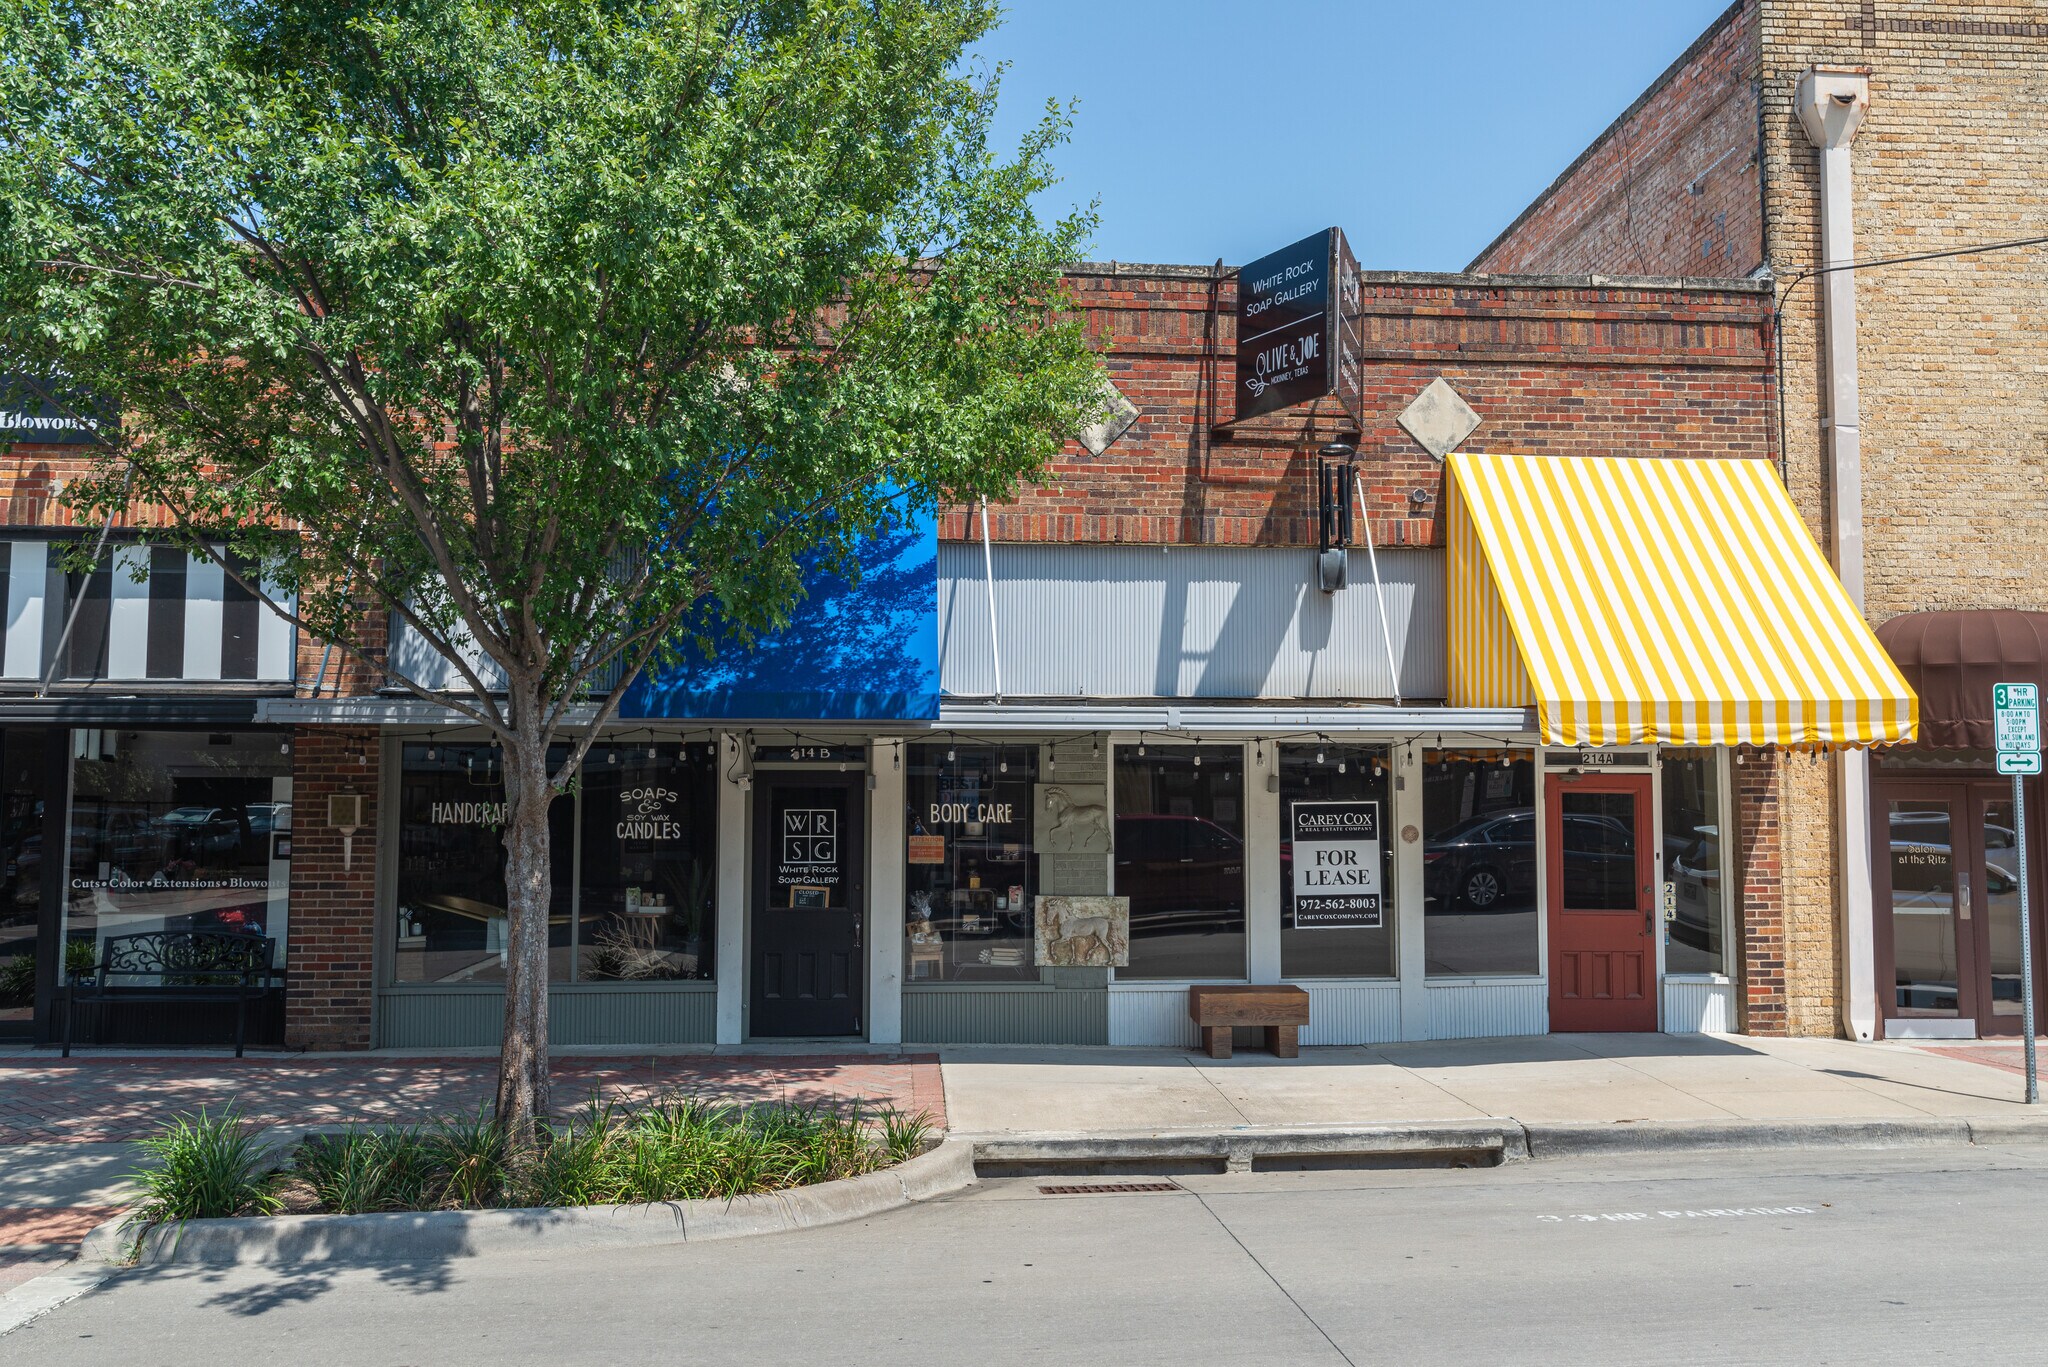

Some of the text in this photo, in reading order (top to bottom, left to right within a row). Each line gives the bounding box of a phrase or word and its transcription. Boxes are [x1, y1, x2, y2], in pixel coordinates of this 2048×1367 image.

[1253, 259, 1314, 294] WHITE ROCK
[1246, 278, 1319, 317] SOAP GALLERY
[1256, 332, 1319, 376] OLIVE & JOE
[1294, 365, 1309, 377] TEXAS
[1997, 688, 2028, 706] 3 HR
[2009, 698, 2036, 707] PARKING
[820, 748, 831, 759] B
[1583, 754, 1613, 765] 214A
[620, 787, 679, 803] SOAPS
[638, 799, 662, 814] &
[930, 803, 971, 823] BODY
[978, 803, 1012, 823] CARE
[1298, 812, 1372, 826] CAREY COX
[616, 822, 681, 839] CANDLES
[1907, 844, 1936, 853] Salon
[1315, 849, 1358, 866] FOR
[1898, 854, 1947, 866] at the Ritz
[779, 865, 838, 873] WHITE ROCK
[71, 878, 101, 889] Cuts
[109, 878, 144, 888] Color
[153, 877, 221, 888] Extensions
[778, 875, 840, 884] SOAP GALLERY
[1304, 869, 1371, 886] LEASE
[1300, 898, 1376, 910] 972-562-8003
[1657, 1206, 1817, 1219] PARKING
